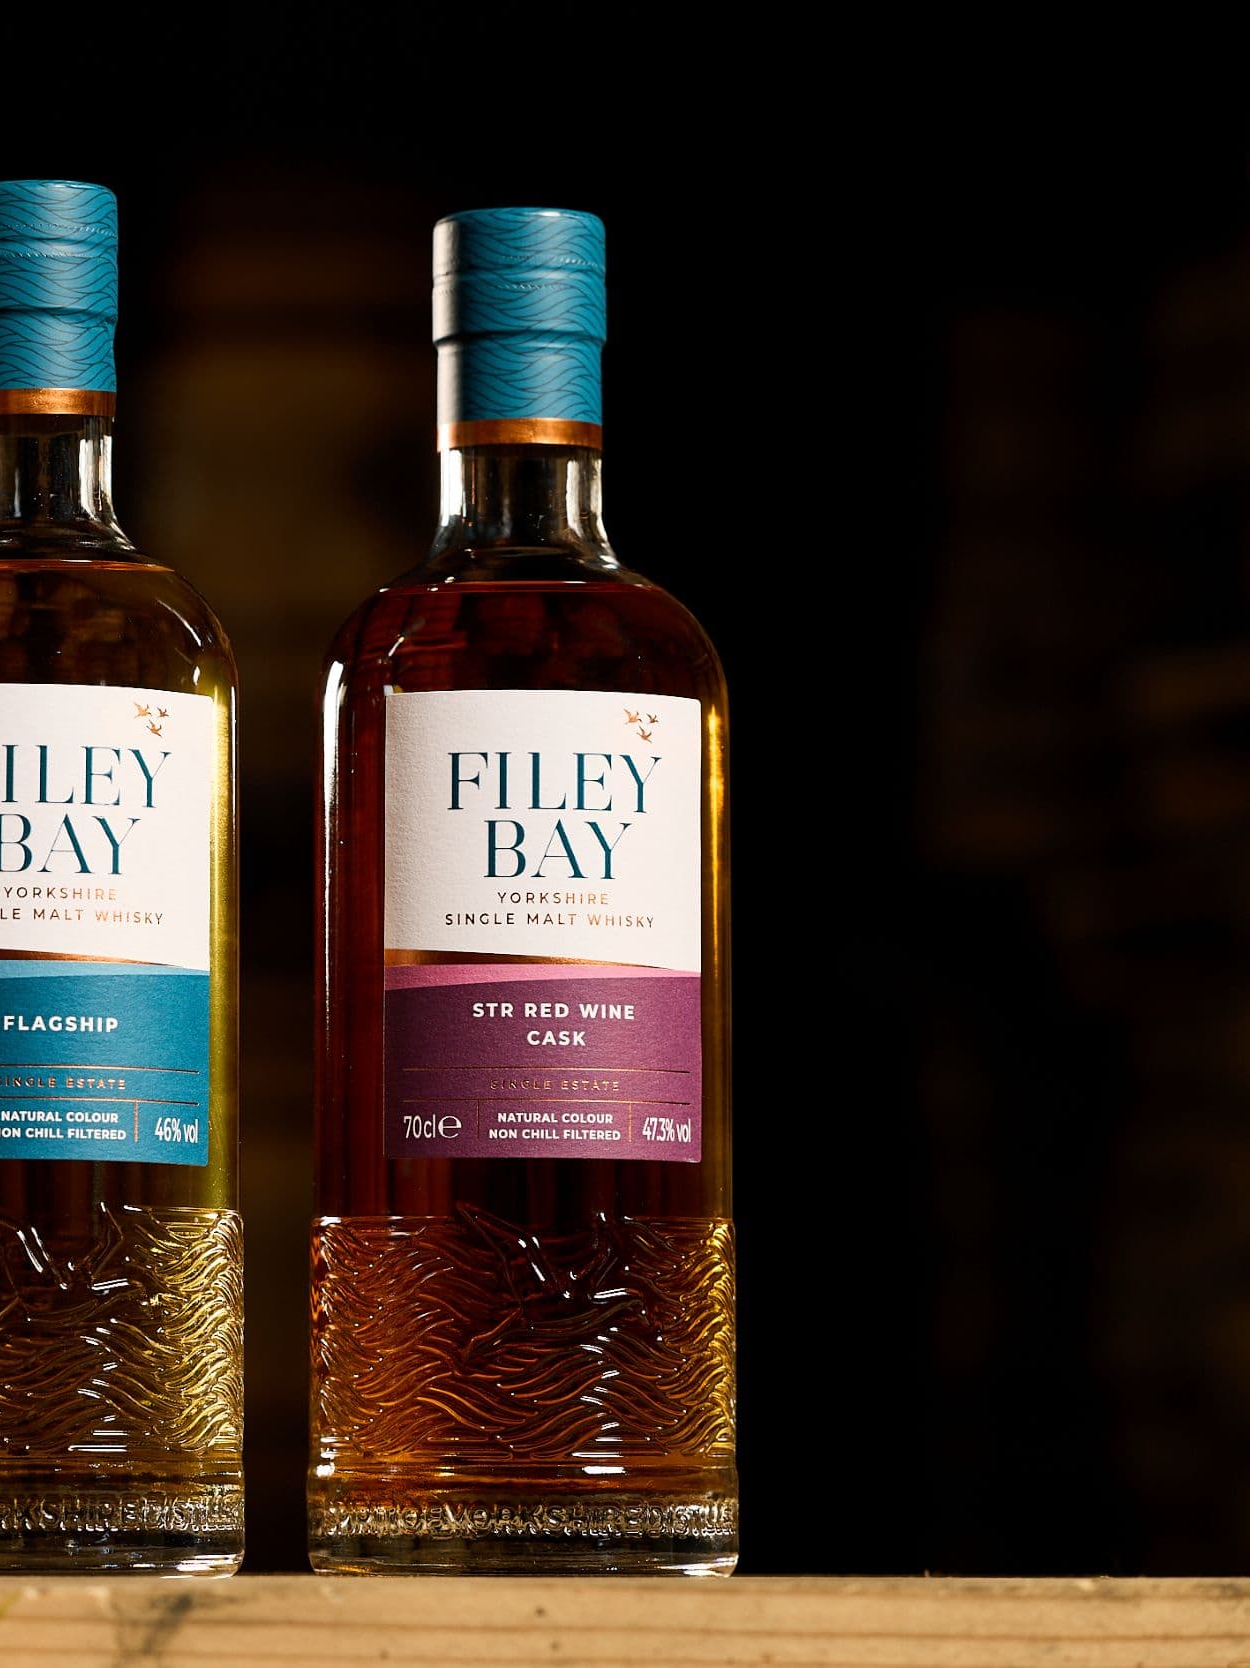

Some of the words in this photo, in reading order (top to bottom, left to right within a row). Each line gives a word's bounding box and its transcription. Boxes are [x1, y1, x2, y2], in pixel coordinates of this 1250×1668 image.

[447, 751, 662, 814] FILEY
[483, 819, 632, 880] BAY
[3, 886, 117, 901] YORKSHIRE
[497, 891, 609, 905] YORKSHIRE
[32, 907, 84, 922] MALT
[94, 909, 164, 925] WHISKY
[444, 912, 515, 926] SINGLE
[526, 913, 577, 926] MALT
[586, 913, 655, 929] WHISKY
[472, 1002, 514, 1018] STR
[525, 1002, 570, 1019] RED
[579, 1003, 636, 1021] WINE
[3, 1015, 119, 1033] FLAGSHIP
[526, 1029, 587, 1046] CASK
[66, 1076, 126, 1090] ESTATE
[489, 1078, 552, 1091] SINGLE
[560, 1079, 621, 1092] ESTATE
[0, 1109, 63, 1122] NATURAL
[66, 1110, 119, 1124] COLOUR
[497, 1111, 559, 1124] NATURAL
[561, 1112, 613, 1125] COLOUR
[25, 1126, 64, 1139] CHILL
[67, 1127, 126, 1141] FILTERED
[154, 1117, 181, 1142] 46%
[183, 1119, 199, 1144] vol
[488, 1128, 519, 1140] NON
[521, 1128, 561, 1141] CHILL
[564, 1129, 621, 1142] FILTERED
[642, 1117, 675, 1143] 47.3%
[676, 1120, 691, 1144] vol
